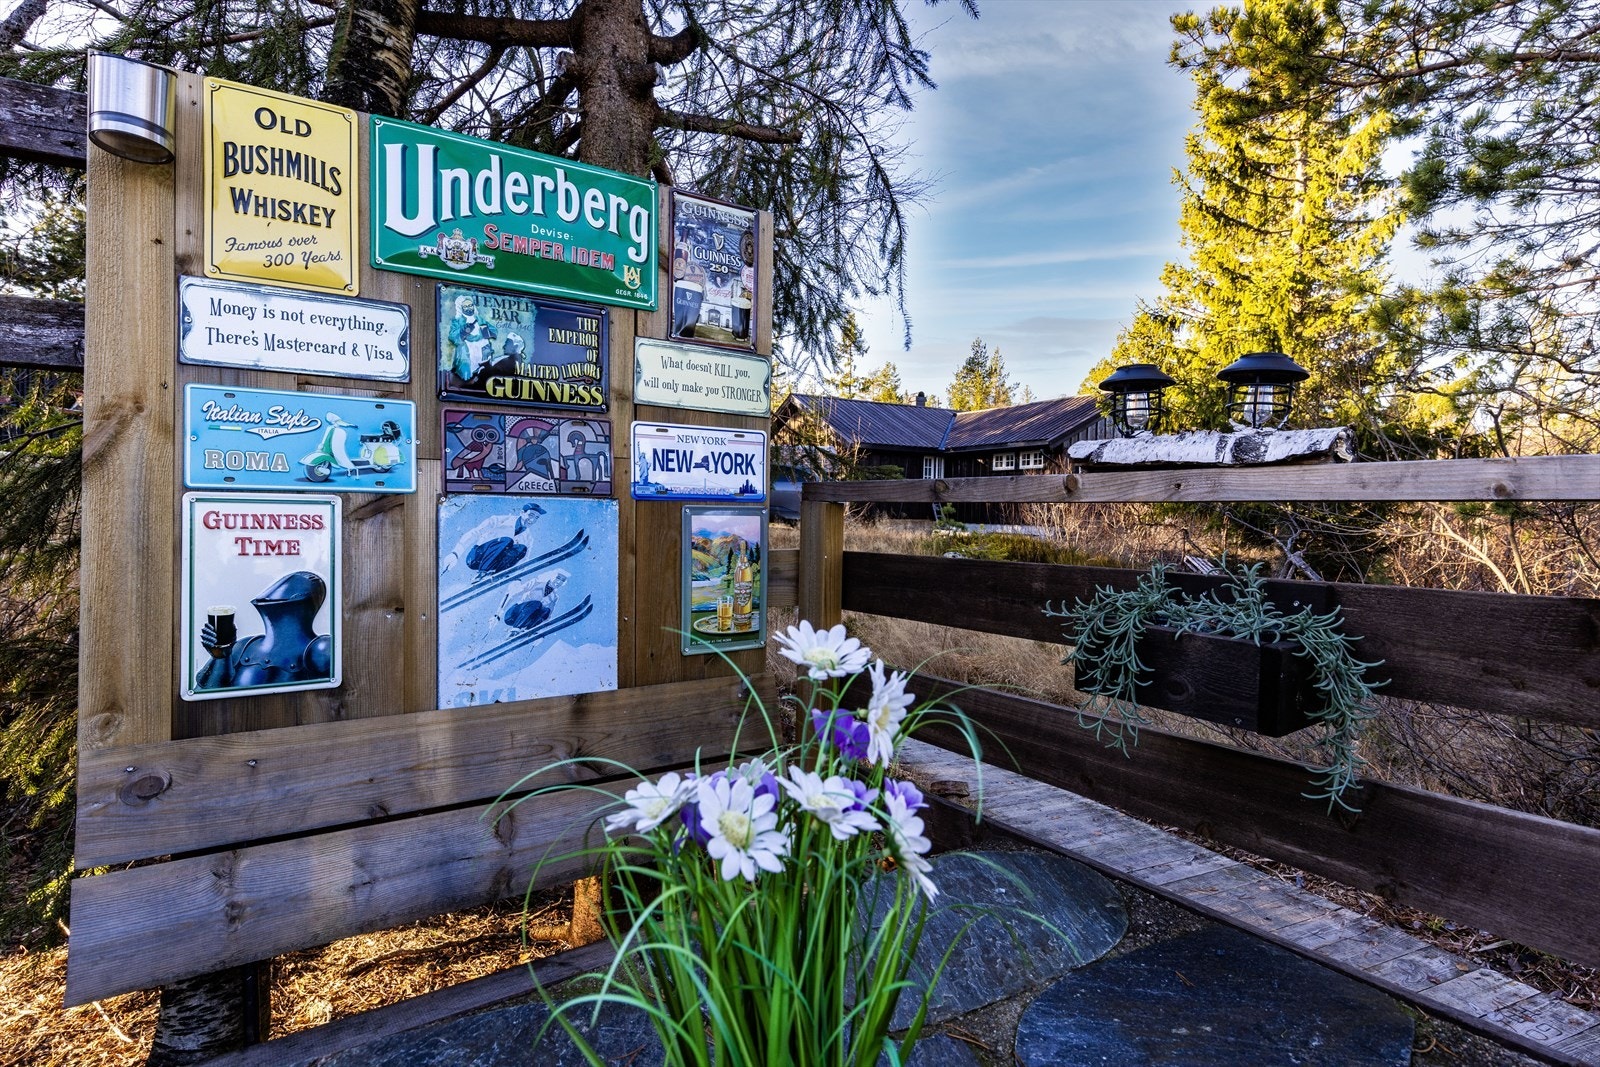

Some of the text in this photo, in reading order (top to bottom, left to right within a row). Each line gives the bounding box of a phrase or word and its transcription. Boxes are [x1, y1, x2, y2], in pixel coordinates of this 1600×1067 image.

[254, 107, 312, 138] OLD
[223, 141, 342, 196] BUSHMILLS
[230, 186, 336, 229] WHISKEY
[383, 143, 650, 264] Underberg
[531, 224, 574, 241] Devise:
[224, 235, 318, 253] Famous over
[483, 224, 615, 272] SEMPER IDEM
[263, 251, 343, 270] 300 Years.
[694, 246, 741, 267] GUINNESS
[709, 263, 729, 274] 250
[473, 294, 533, 312] TEMPLE
[209, 297, 388, 336] Money is not everything.
[491, 308, 521, 324] BAR
[577, 317, 598, 332] THE
[205, 326, 394, 362] There's Mastercard & Visa
[548, 327, 598, 348] EMPEROR
[586, 349, 598, 363] OF
[514, 361, 559, 380] MALTED
[661, 356, 683, 371] What
[714, 363, 733, 378] KILL
[485, 375, 603, 406] GUINNESS
[643, 377, 762, 403] will only make you STRONGER
[202, 399, 315, 430] Italian Style
[257, 427, 279, 435] ITALIA
[677, 434, 727, 446] NEW YORK
[204, 449, 290, 473] ROMA
[652, 448, 756, 476] NEW YORK
[518, 480, 554, 492] GREECE
[203, 510, 324, 530] GUINNESS
[234, 536, 301, 556] TIME
